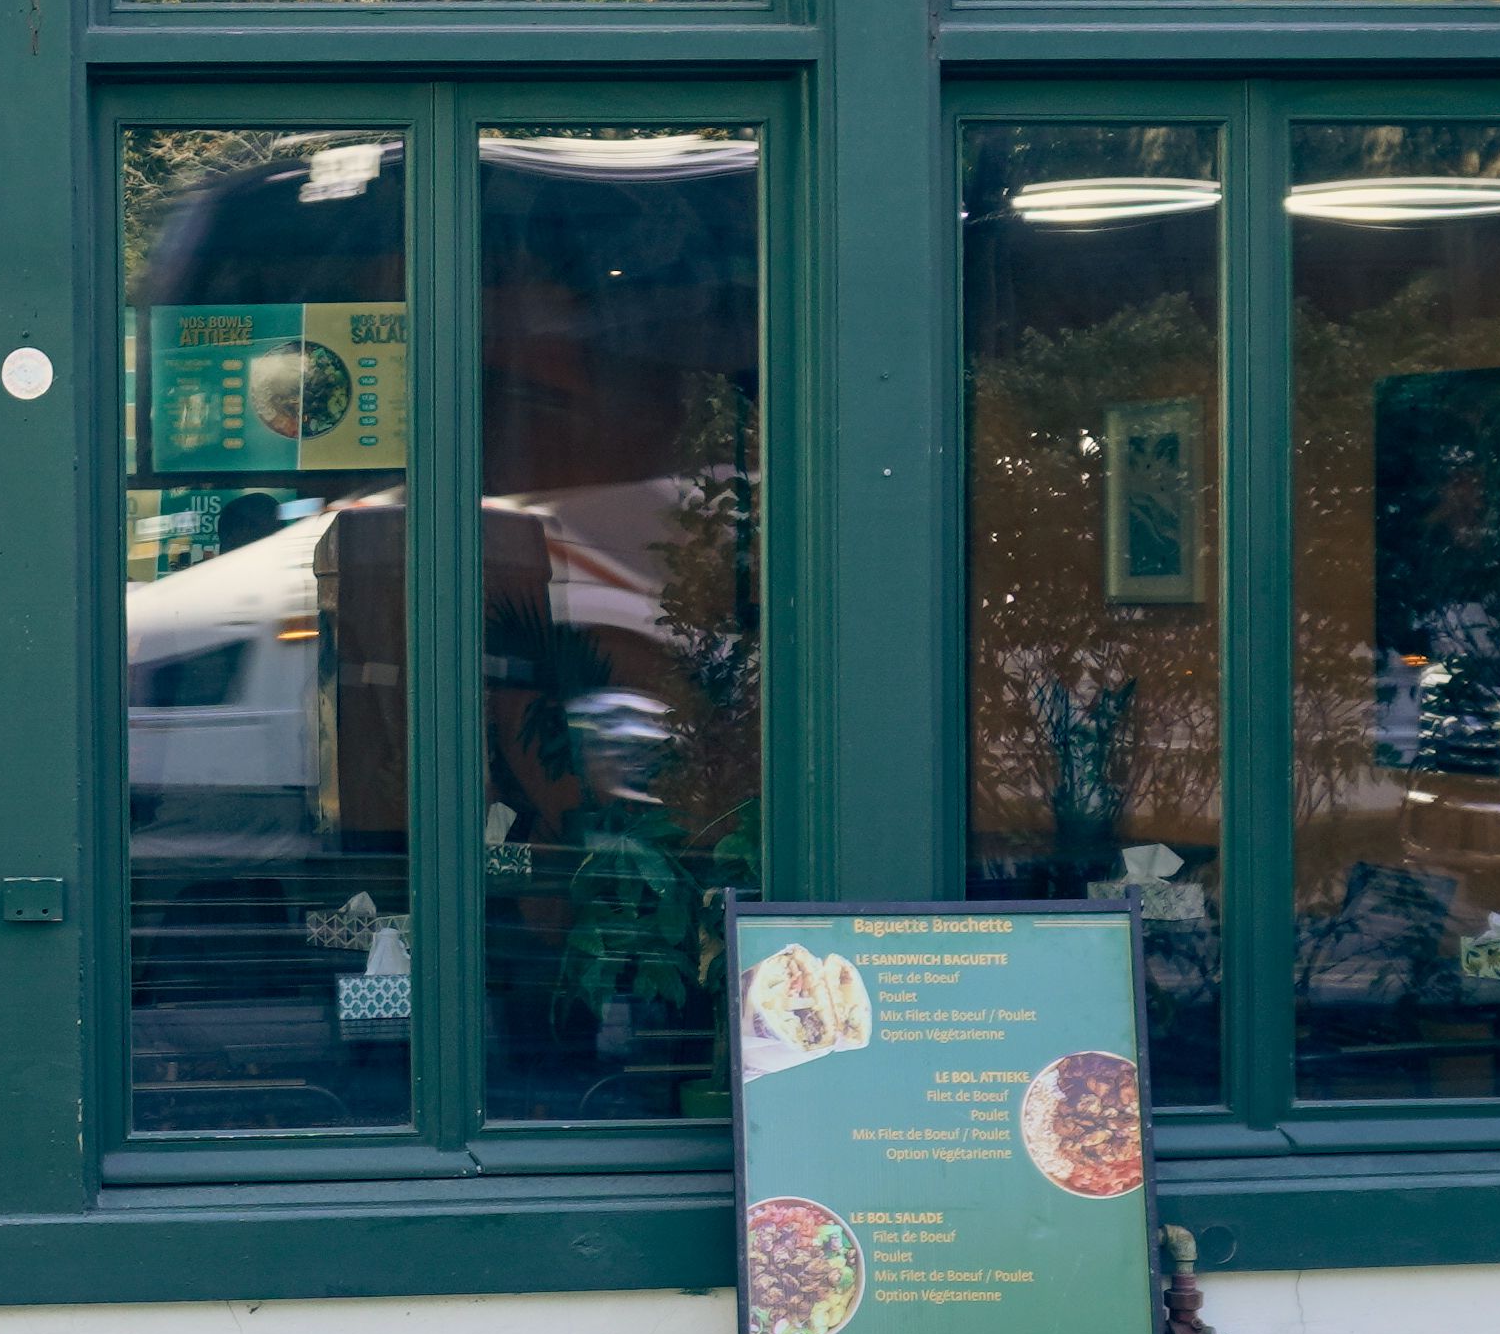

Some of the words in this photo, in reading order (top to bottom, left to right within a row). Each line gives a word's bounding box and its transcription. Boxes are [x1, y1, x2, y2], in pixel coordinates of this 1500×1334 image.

[210, 315, 253, 328] BOWLS
[184, 495, 222, 515] JUS
[854, 919, 929, 937] Baguette
[933, 917, 1013, 933] Brochette
[856, 954, 870, 965] LE
[872, 954, 941, 965] SANDWICH
[944, 953, 1008, 965] BAGUETTE
[878, 972, 904, 983] Filet
[906, 972, 921, 983] de
[924, 971, 960, 983] Boeuf
[879, 991, 917, 1002] Poulet
[880, 1011, 902, 1021] Mix
[906, 1010, 931, 1021] Filet
[934, 1010, 949, 1021] de
[951, 1009, 986, 1021] Boeuf
[998, 1009, 1036, 1021] Poulet
[881, 1029, 923, 1042] Option
[926, 1028, 1005, 1043] Végétarienne
[935, 1071, 949, 1083] LE
[951, 1071, 978, 1083] BOL
[980, 1071, 1030, 1083] ATTIEKE
[927, 1090, 952, 1102] Filet
[955, 1090, 970, 1101] de
[973, 1089, 1009, 1102] Boeuf
[971, 1108, 1010, 1121] Poulet
[853, 1129, 876, 1140] Mix
[878, 1128, 903, 1140] Filet
[906, 1128, 922, 1140] de
[924, 1128, 960, 1140] Boeuf
[972, 1128, 1011, 1140] Poulet
[886, 1148, 929, 1161] Option
[932, 1147, 1012, 1162] Végétarienne
[851, 1212, 864, 1224] LE
[867, 1212, 892, 1224] BOL
[896, 1212, 943, 1224] SALADE
[873, 1231, 899, 1243] Filet
[902, 1231, 917, 1243] de
[920, 1229, 956, 1243] Boeuf
[874, 1250, 913, 1262] Poulet
[875, 1270, 897, 1282] Mix
[900, 1270, 926, 1282] Filet
[929, 1270, 944, 1282] de
[947, 1269, 983, 1282] Boeuf
[995, 1270, 1034, 1282] Poulet
[875, 1289, 918, 1303] Option
[922, 1288, 1002, 1304] Végétarienne
